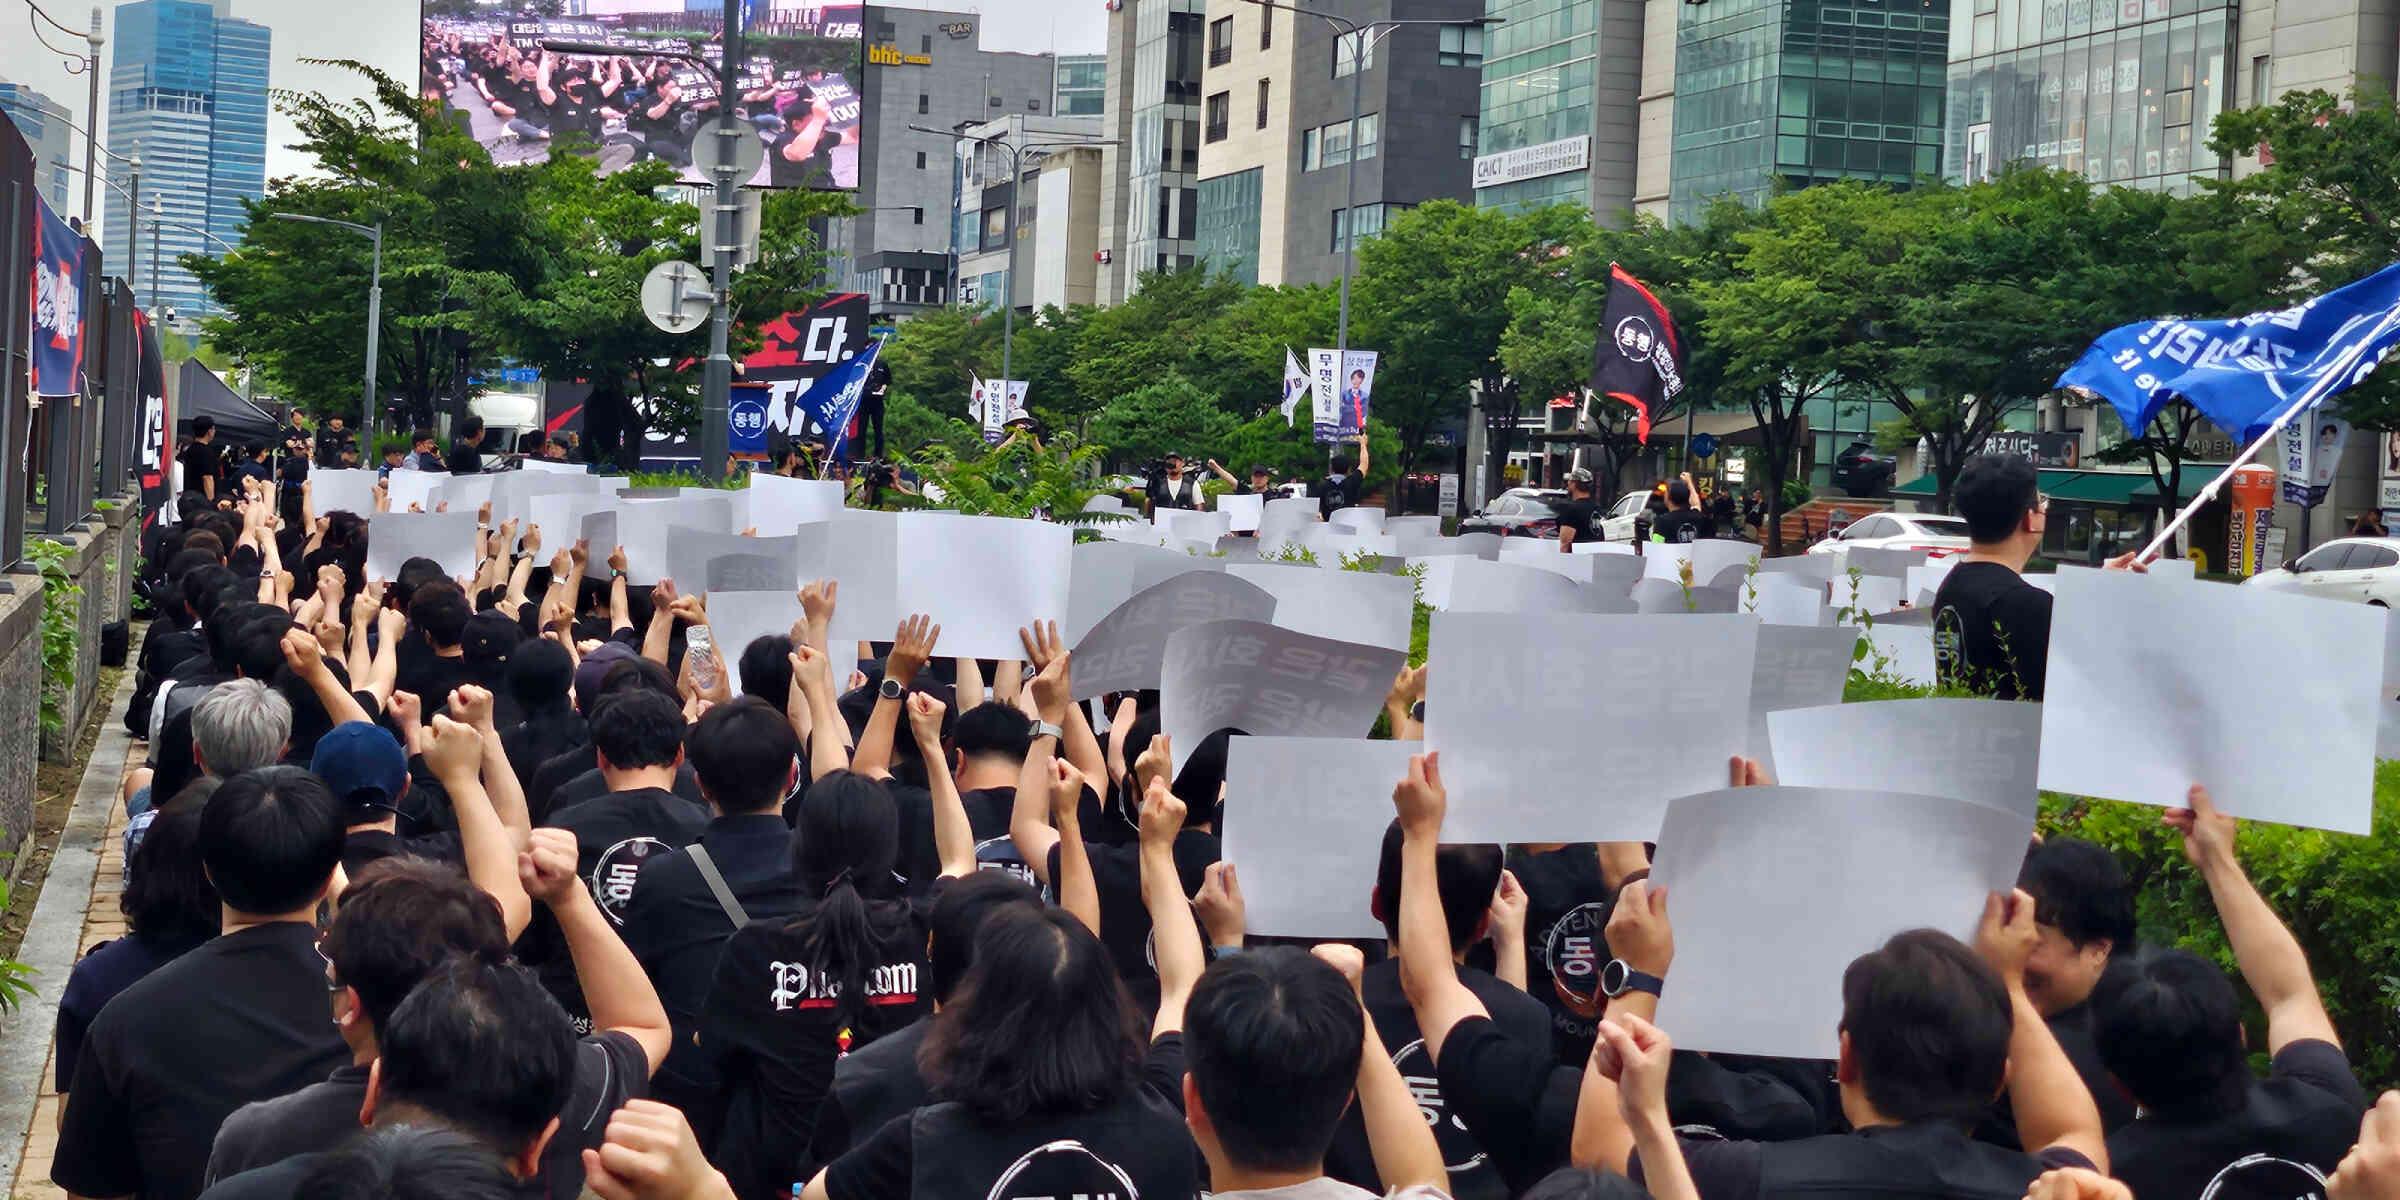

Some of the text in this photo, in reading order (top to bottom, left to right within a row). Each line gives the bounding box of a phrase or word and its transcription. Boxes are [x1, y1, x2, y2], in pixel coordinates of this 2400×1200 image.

[869, 43, 902, 65] bhc
[1319, 352, 1333, 413] 무명전설
[2286, 422, 2304, 474] 명전설
[606, 863, 639, 901] 동
[1560, 936, 1595, 976] 동
